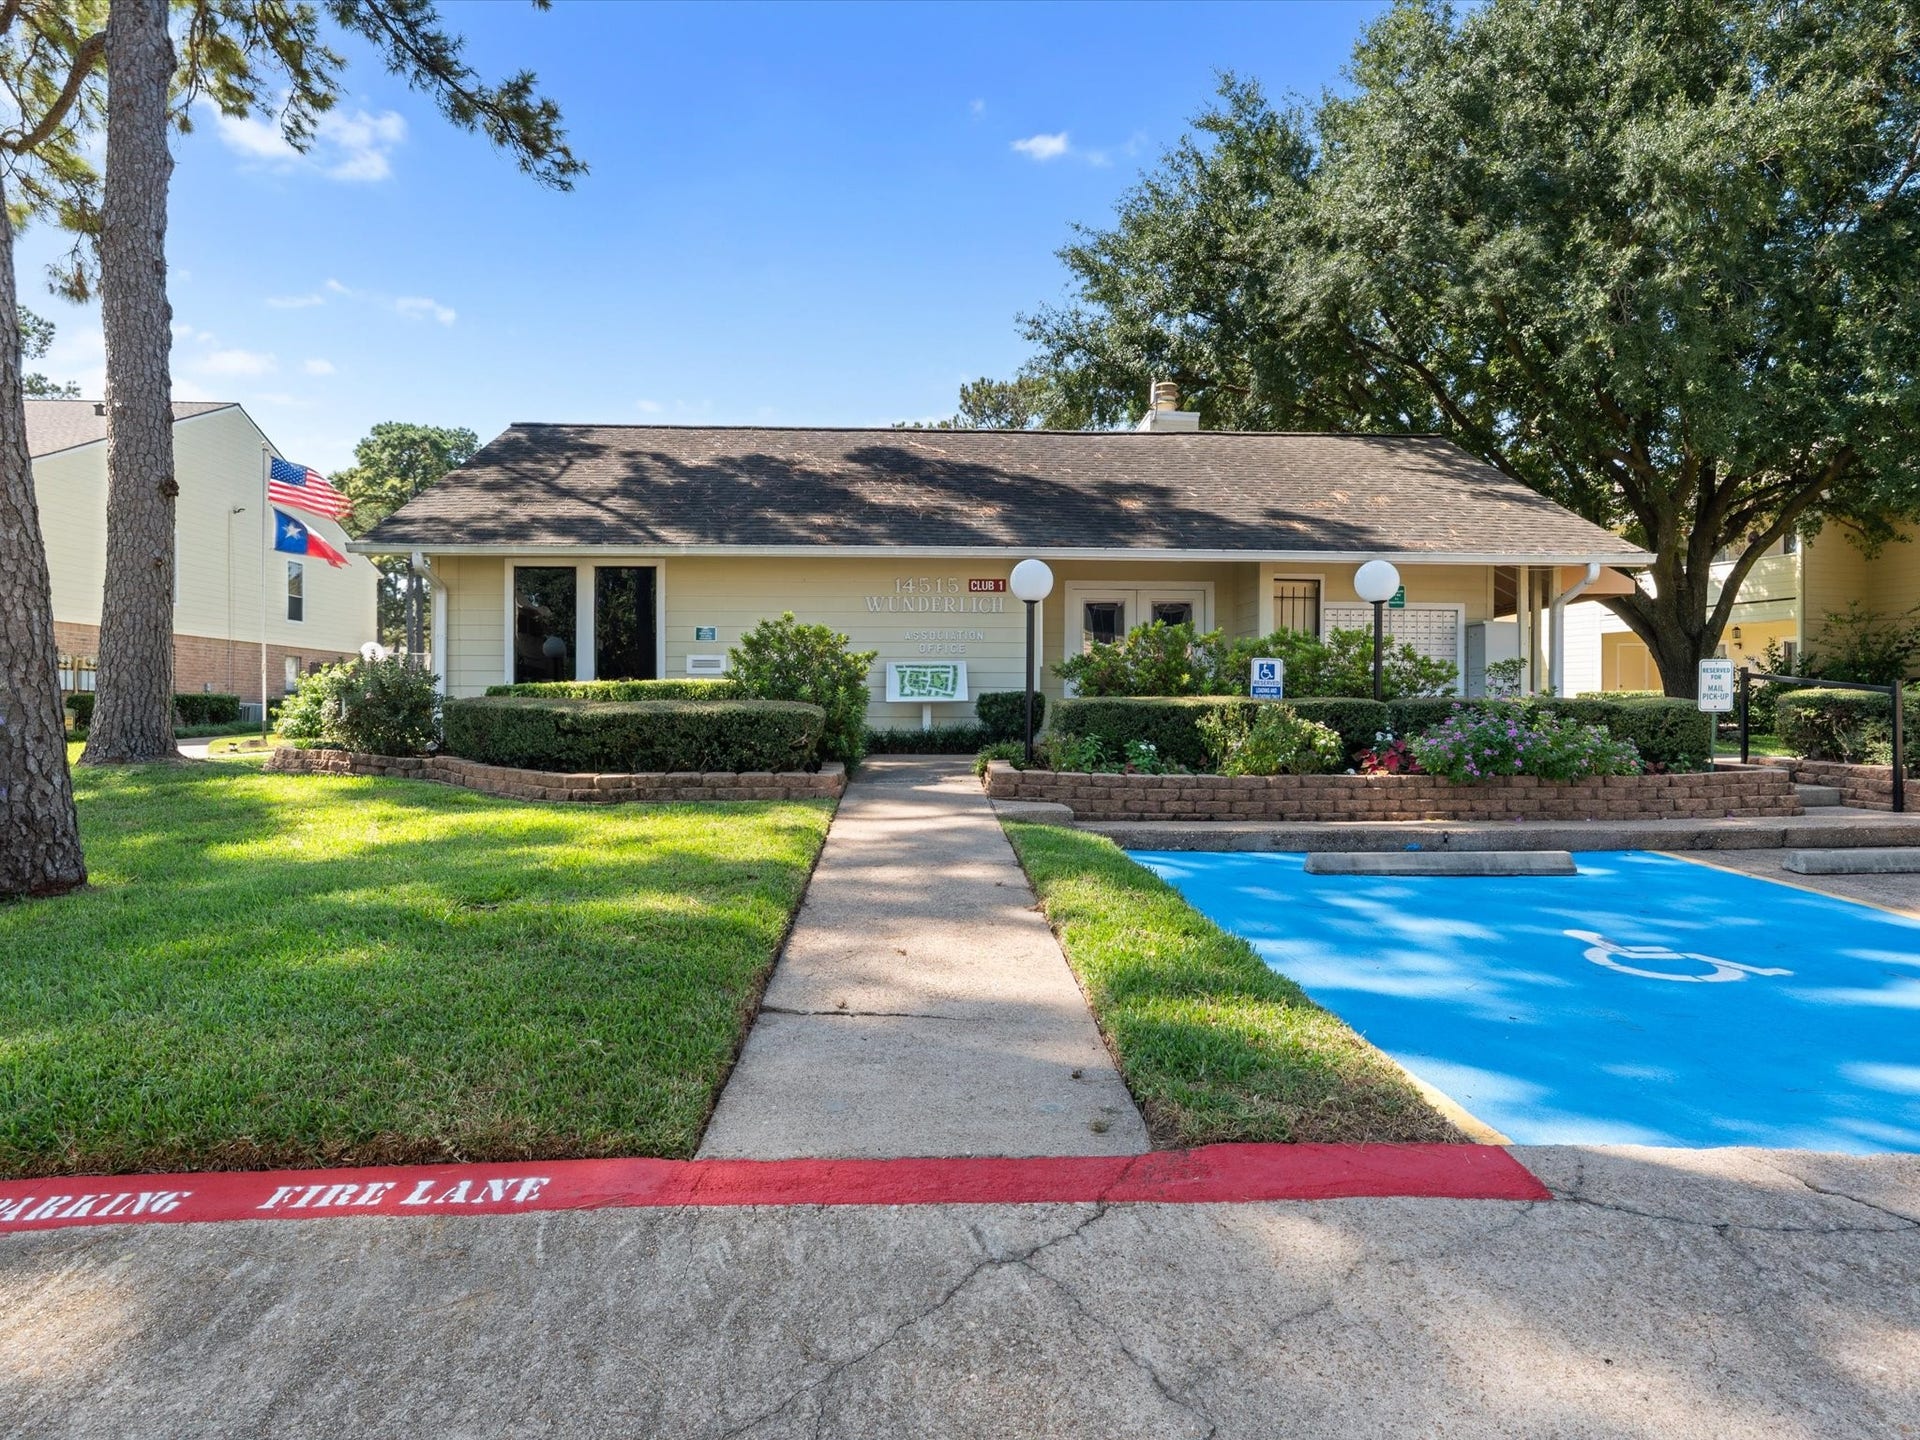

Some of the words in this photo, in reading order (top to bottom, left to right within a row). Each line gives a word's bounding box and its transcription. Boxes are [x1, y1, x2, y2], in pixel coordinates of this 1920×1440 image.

[895, 577, 960, 594] 14515
[970, 580, 995, 591] CLUB
[998, 580, 1004, 591] 1
[865, 596, 1004, 613] WUNDERLICH
[903, 630, 984, 641] ASSOCIATION
[918, 643, 967, 654] OFFICE
[256, 1181, 396, 1210] FIRE
[399, 1176, 551, 1208] LANE
